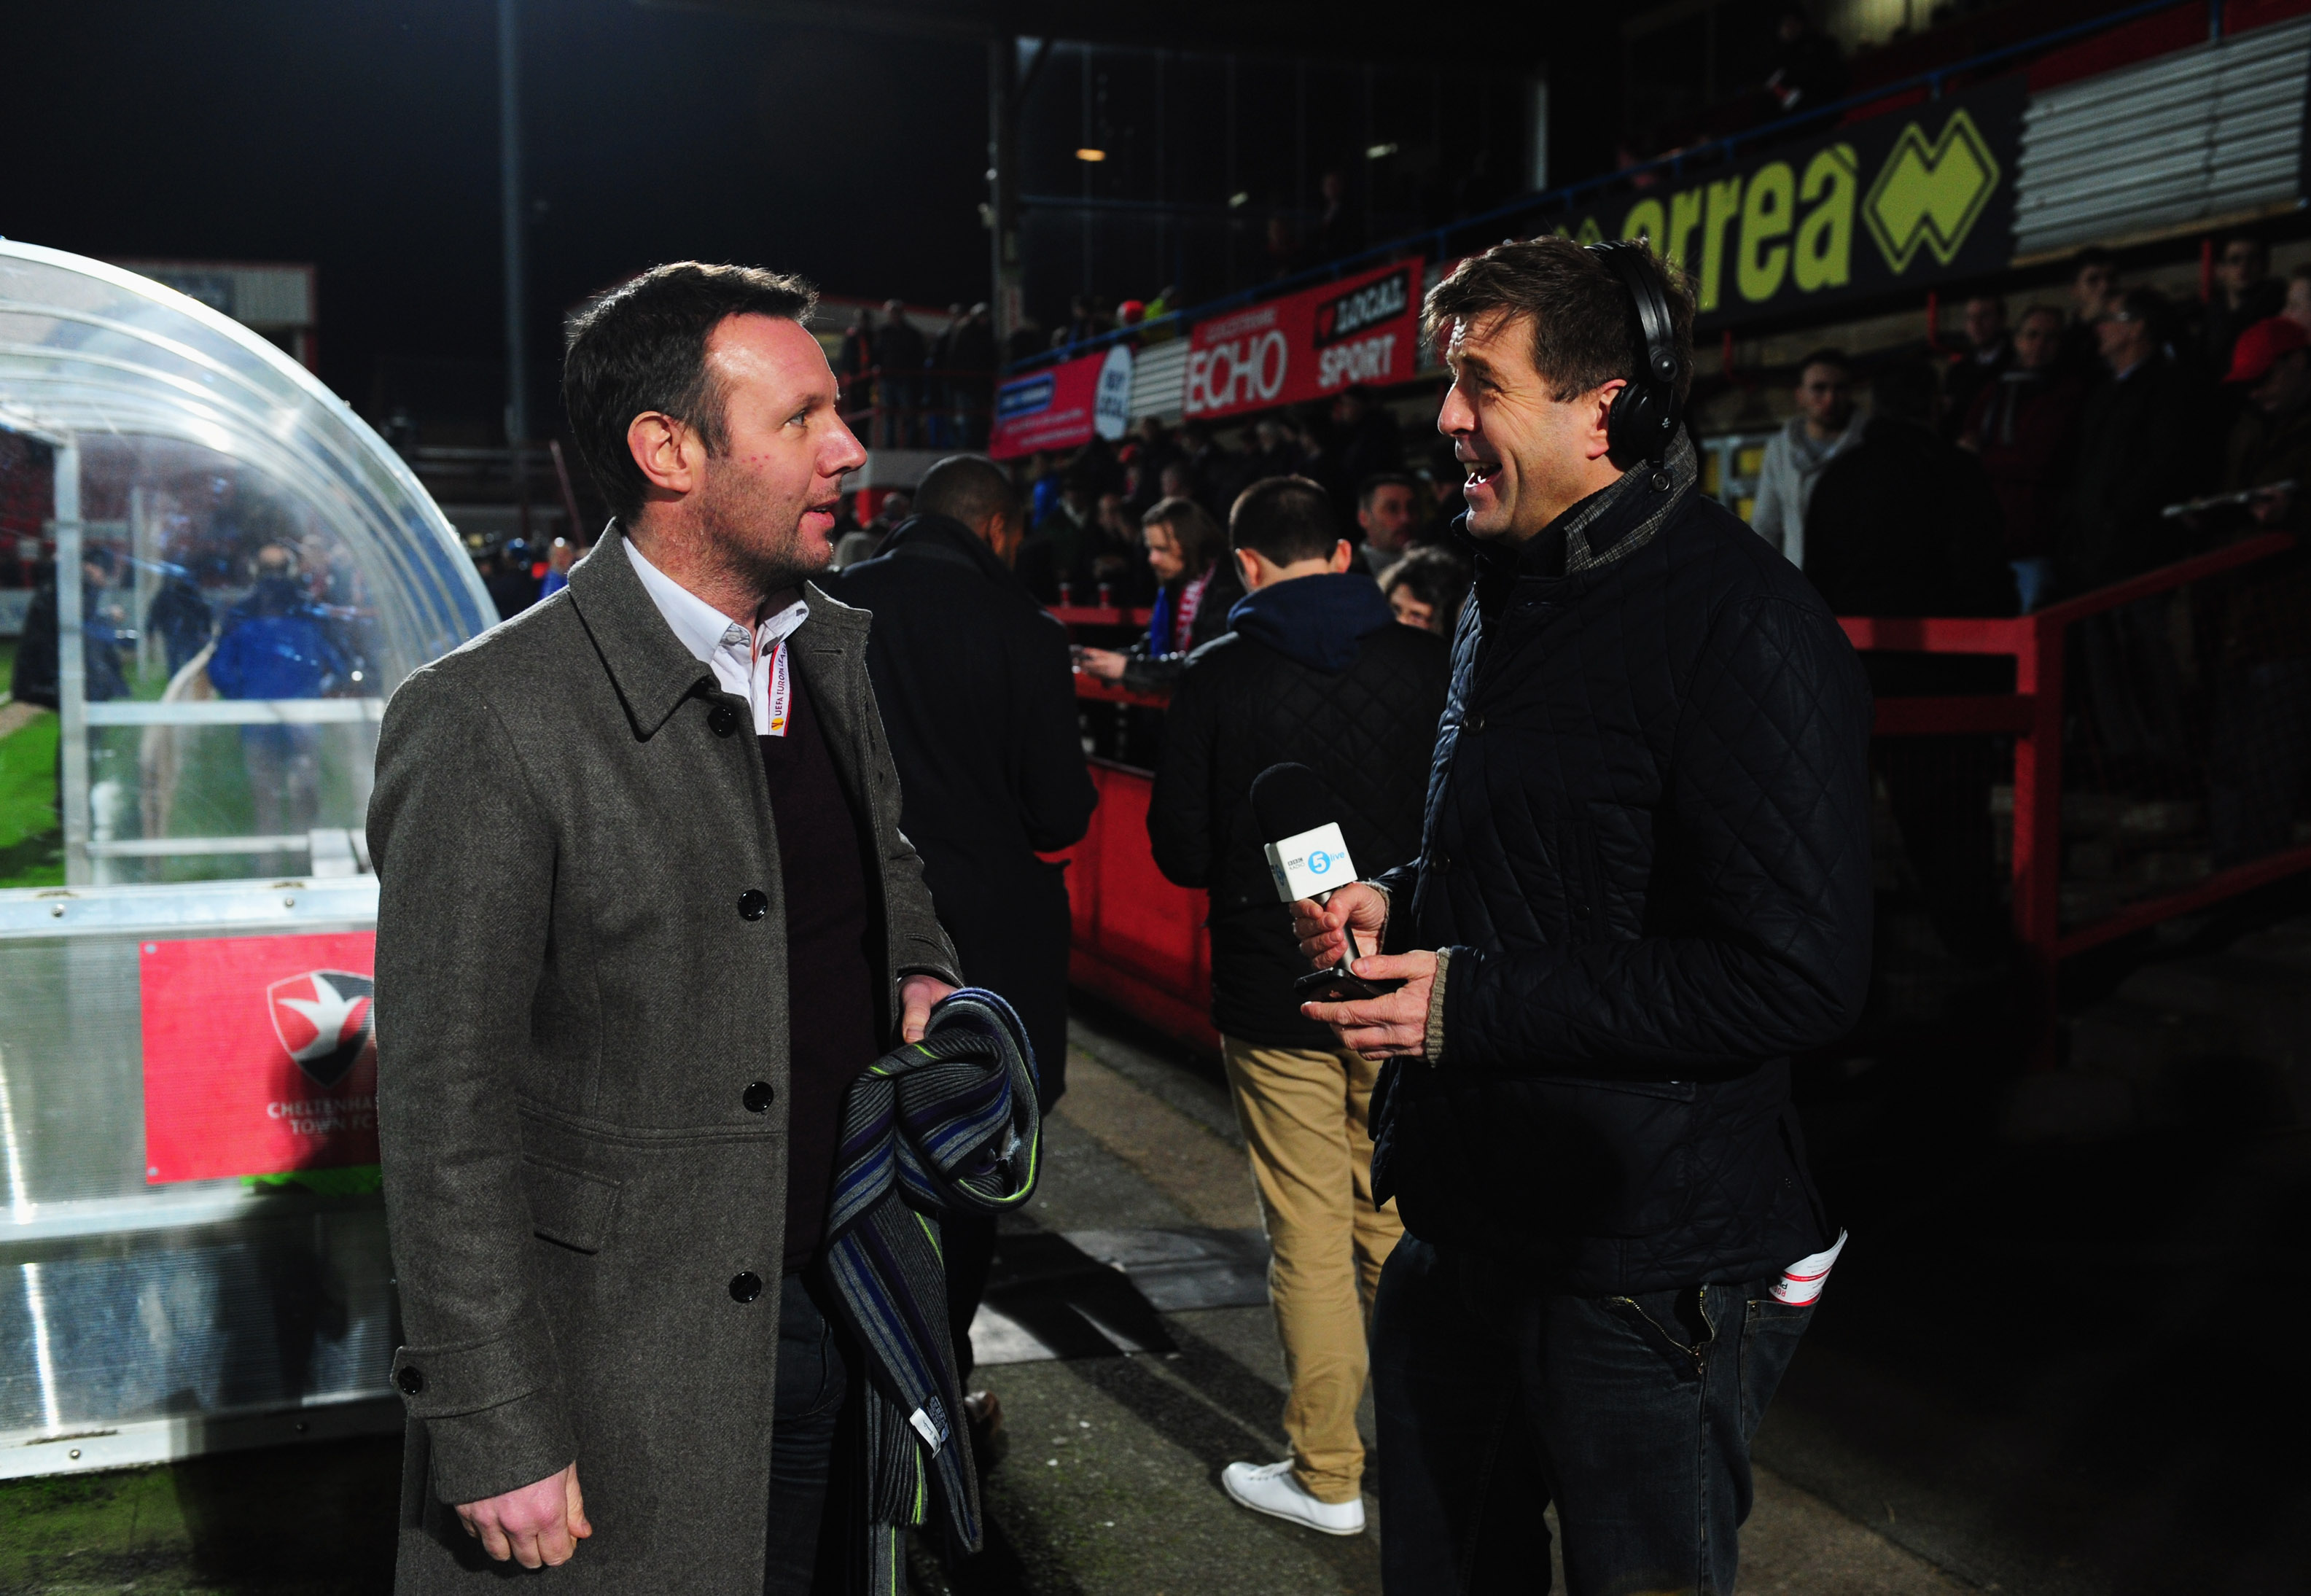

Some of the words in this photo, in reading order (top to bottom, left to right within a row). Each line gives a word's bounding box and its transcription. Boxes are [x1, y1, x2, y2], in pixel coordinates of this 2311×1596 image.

[1334, 274, 1407, 335] LOCAL
[1185, 328, 1288, 413] ECHO
[1317, 332, 1398, 389] SPORT
[776, 667, 785, 696] EUROPA
[775, 696, 784, 716] UEFA
[1312, 852, 1327, 873] 5
[1330, 852, 1345, 863] live
[266, 1095, 373, 1120] CHELTENHA
[289, 1116, 347, 1136] TOWN
[351, 1113, 373, 1130] FC
